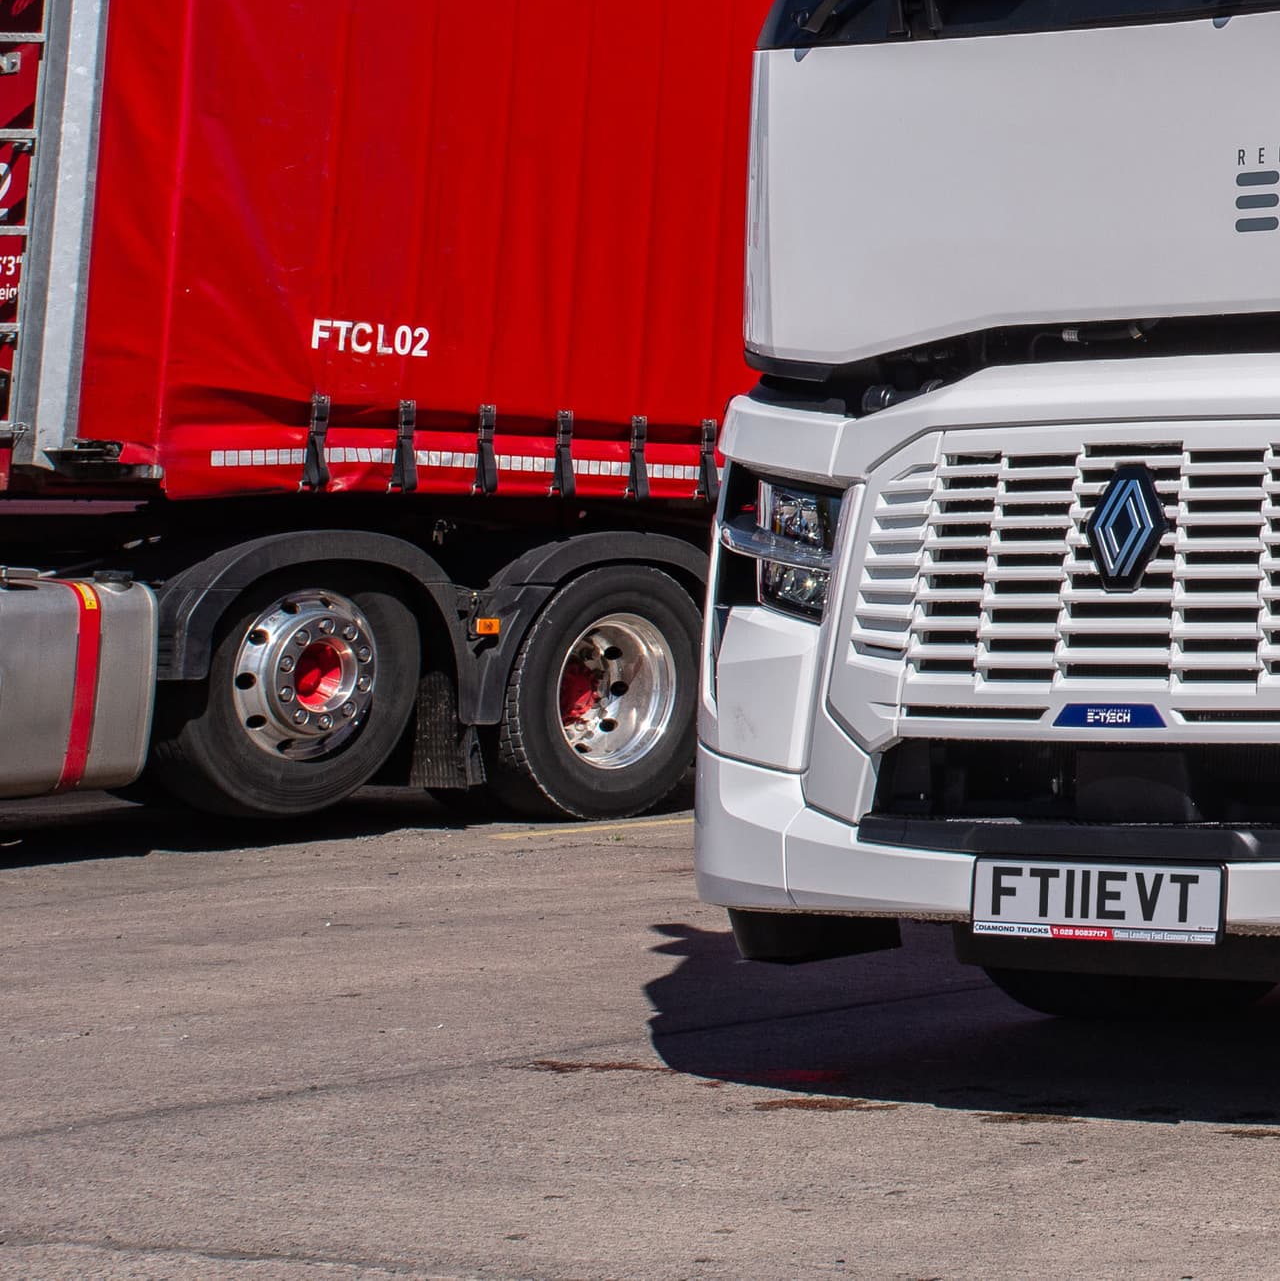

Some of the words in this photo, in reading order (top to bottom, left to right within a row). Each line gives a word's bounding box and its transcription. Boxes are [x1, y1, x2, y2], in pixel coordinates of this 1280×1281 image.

[1087, 711, 1131, 723] E-TECH
[978, 924, 1015, 932] DIAMOND
[1017, 926, 1049, 934] TRUCKS
